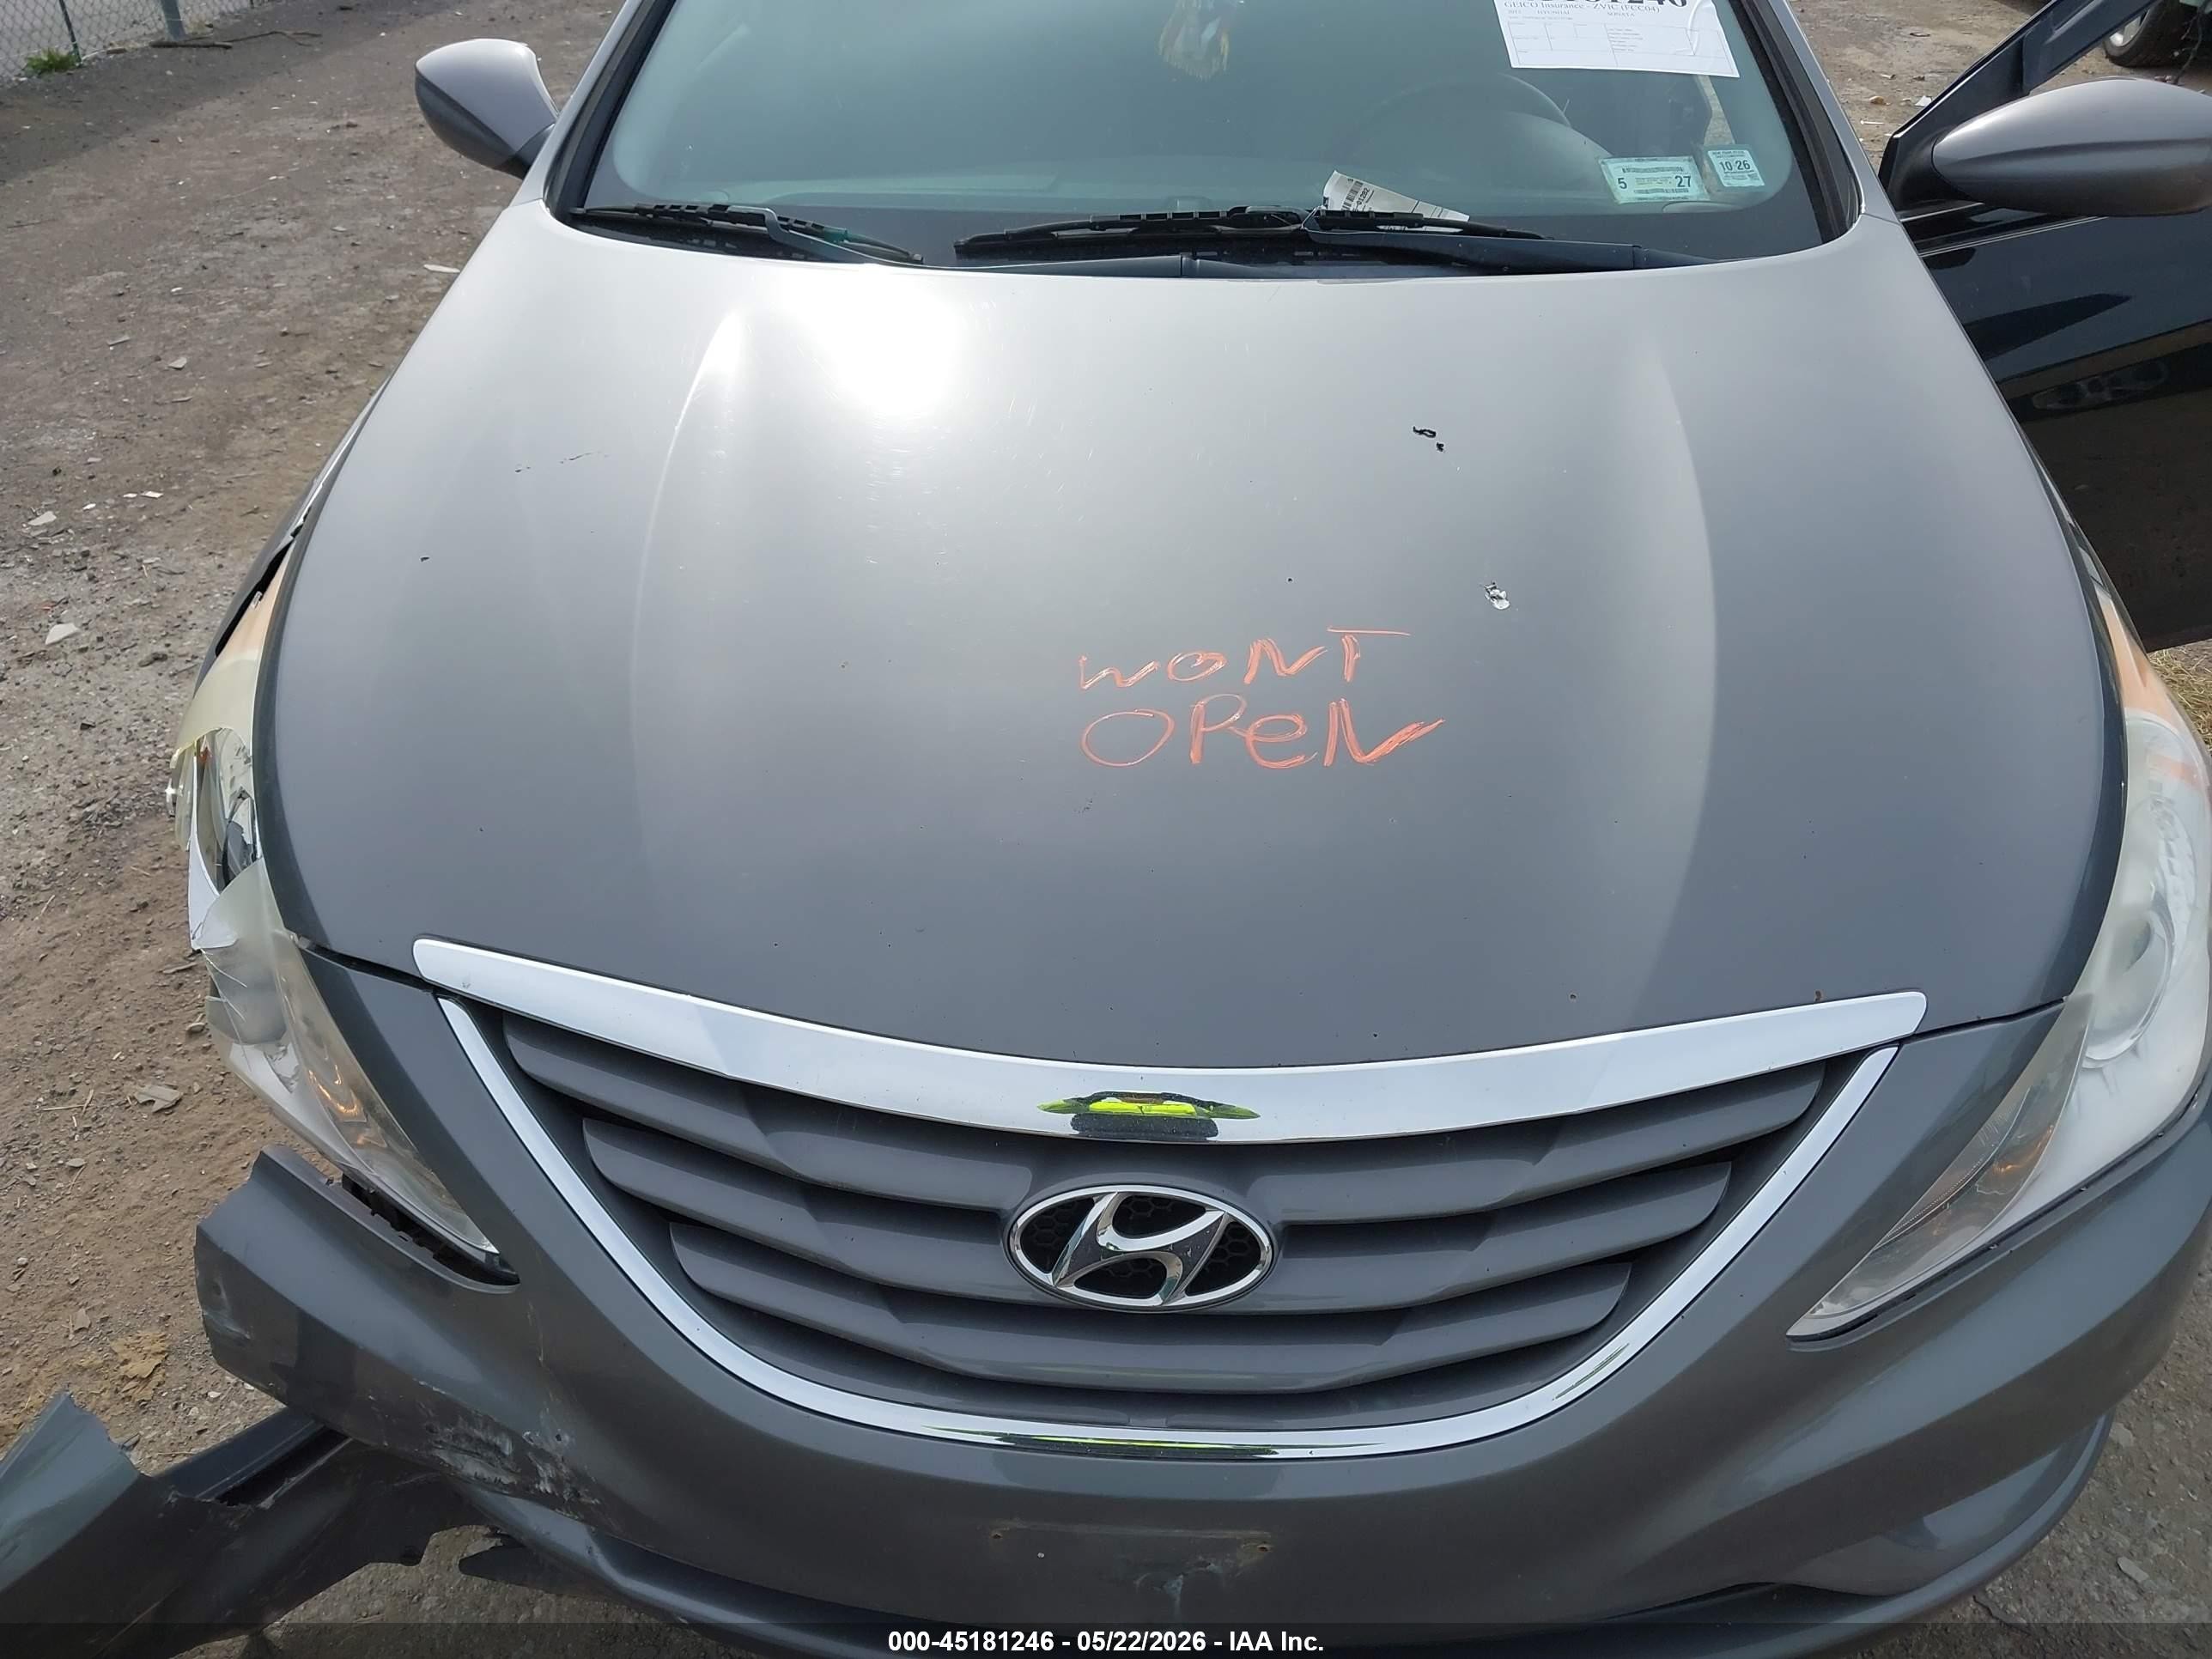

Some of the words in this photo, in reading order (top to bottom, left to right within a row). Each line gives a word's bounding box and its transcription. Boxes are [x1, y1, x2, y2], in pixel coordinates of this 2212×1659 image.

[1719, 161, 1733, 171] 10
[1735, 160, 1751, 170] 26
[1618, 178, 1627, 190] 5
[1674, 175, 1692, 188] 27
